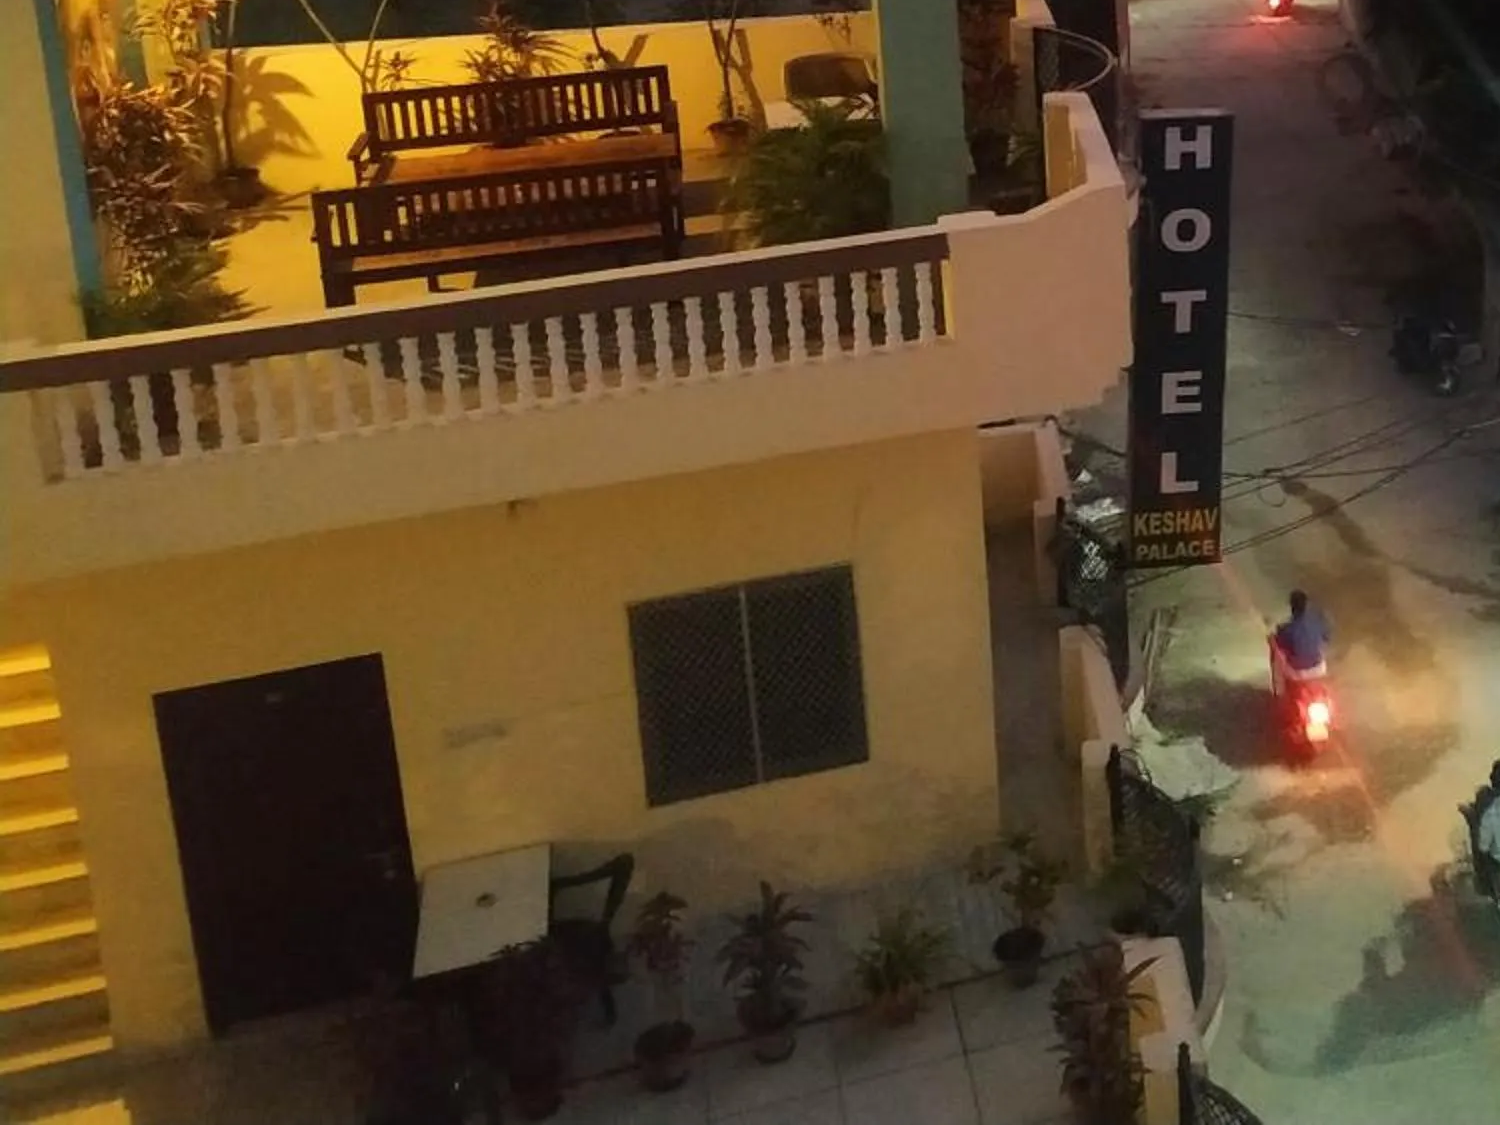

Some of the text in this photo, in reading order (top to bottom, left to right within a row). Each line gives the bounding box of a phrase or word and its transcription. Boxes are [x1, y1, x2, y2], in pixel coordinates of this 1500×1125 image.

[1161, 126, 1211, 493] HOTEL
[1134, 508, 1217, 536] KESHAV
[1137, 541, 1216, 561] PALACE
